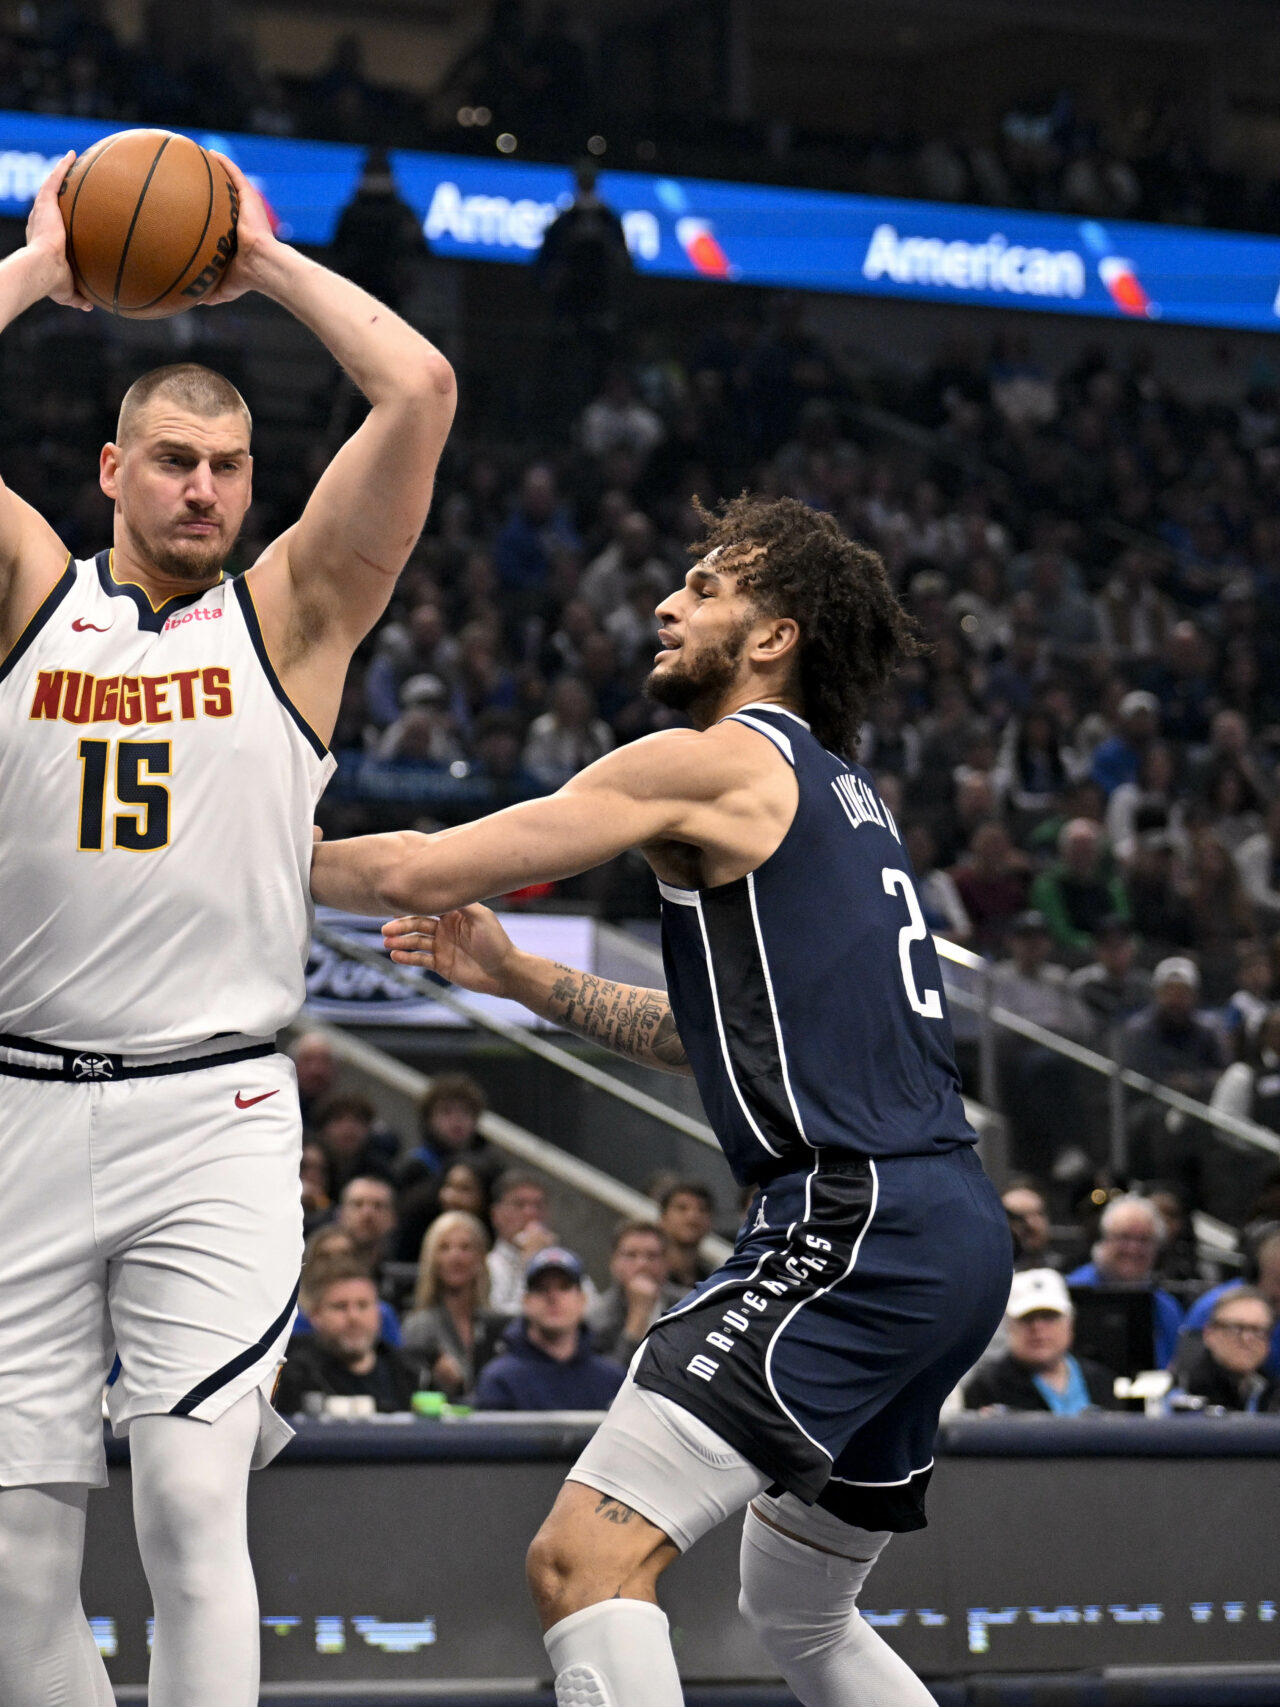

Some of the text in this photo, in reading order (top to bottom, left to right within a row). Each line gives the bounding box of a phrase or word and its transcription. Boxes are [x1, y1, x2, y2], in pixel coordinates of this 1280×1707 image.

[862, 224, 1085, 299] American
[164, 608, 223, 631] ibotta
[28, 665, 235, 727] NUGGETS
[76, 737, 172, 853] 15
[882, 867, 943, 1018] 2
